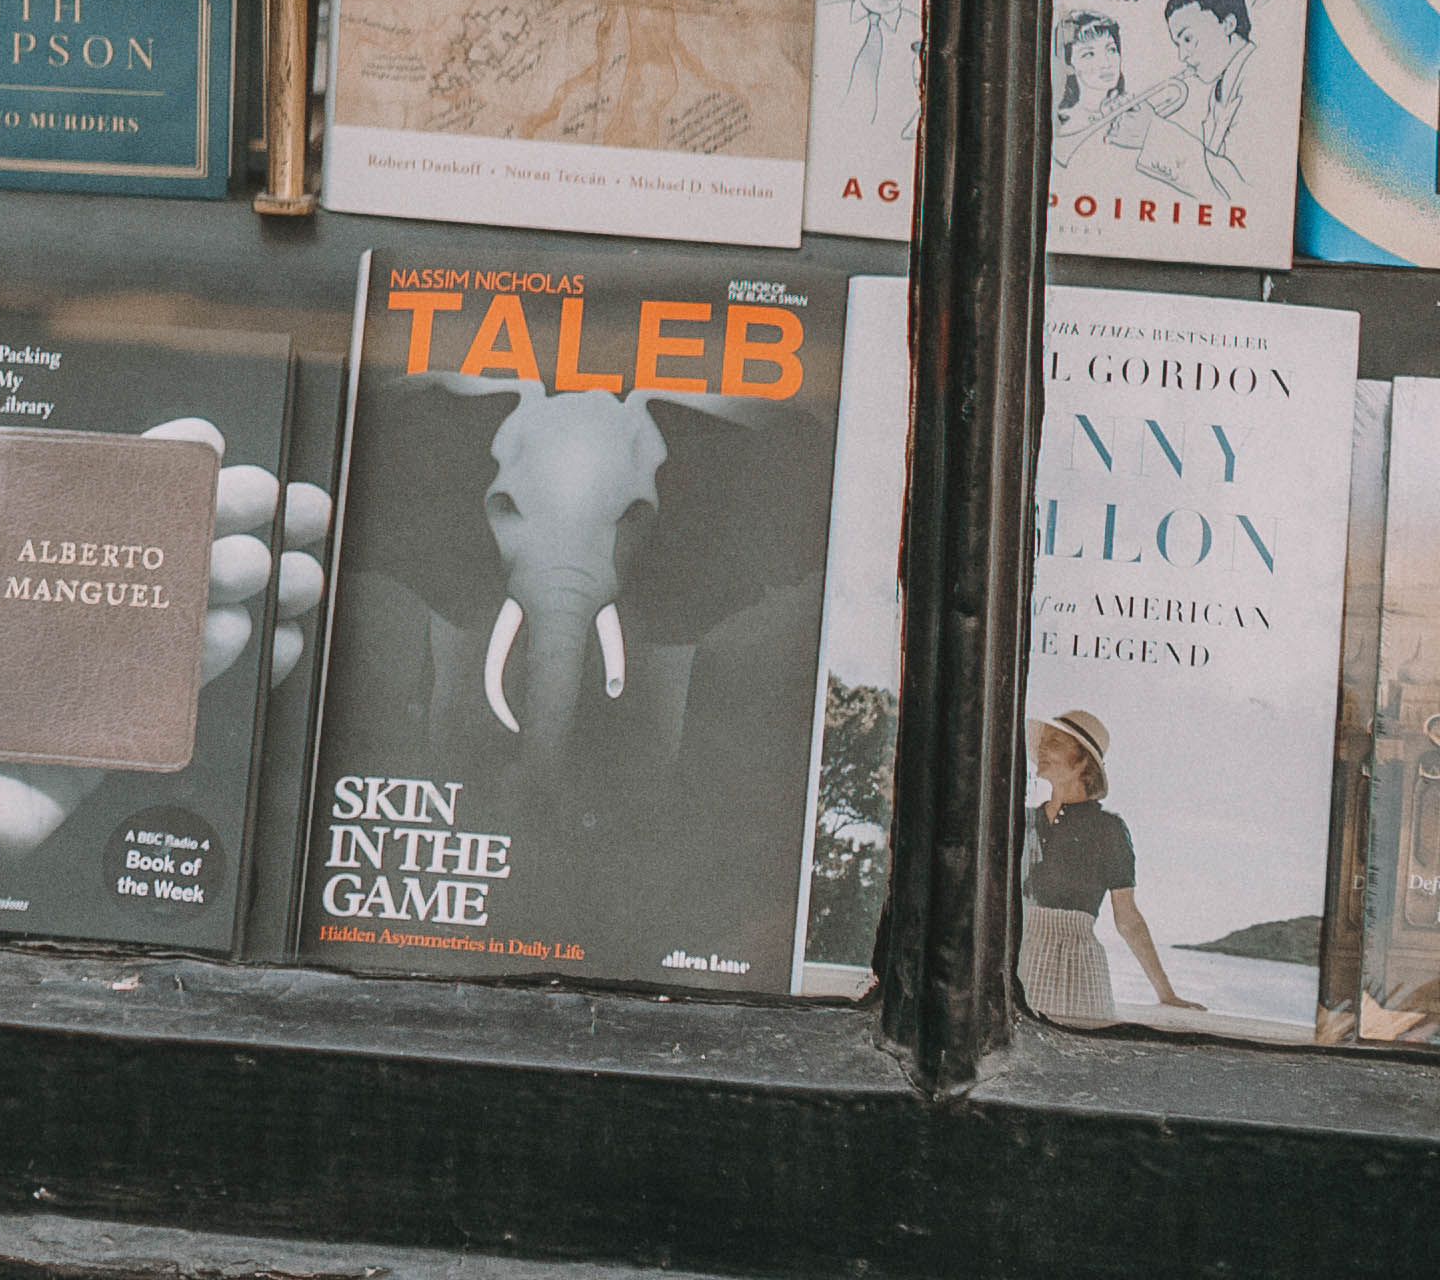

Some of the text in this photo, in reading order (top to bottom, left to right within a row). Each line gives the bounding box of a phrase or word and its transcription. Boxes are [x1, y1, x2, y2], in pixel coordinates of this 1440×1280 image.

[29, 111, 142, 134] MURDERS
[368, 153, 418, 171] Robert
[422, 158, 482, 177] Dankoff
[505, 164, 551, 182] Nuran
[630, 175, 686, 194] Michael
[711, 182, 775, 200] Sheridan
[389, 268, 585, 296] NASSIM NICHOLAS
[386, 290, 806, 402] TALEB
[1089, 322, 1269, 351] TIMES BESTSELLER
[1087, 352, 1300, 400] GORDON
[17, 538, 165, 571] ALBERTO
[3, 575, 171, 609] MANGUEL
[1053, 592, 1274, 630] an AMERICAN
[1070, 633, 1211, 669] LEGEND
[331, 775, 463, 826] SKIN
[125, 829, 136, 842] A
[200, 839, 211, 852] 4
[324, 824, 512, 879] IN THE
[125, 848, 203, 878] Book of
[116, 875, 205, 904] the Week
[321, 873, 489, 927] GAME
[319, 925, 586, 961] Hidden Asymmetries in Daily Life
